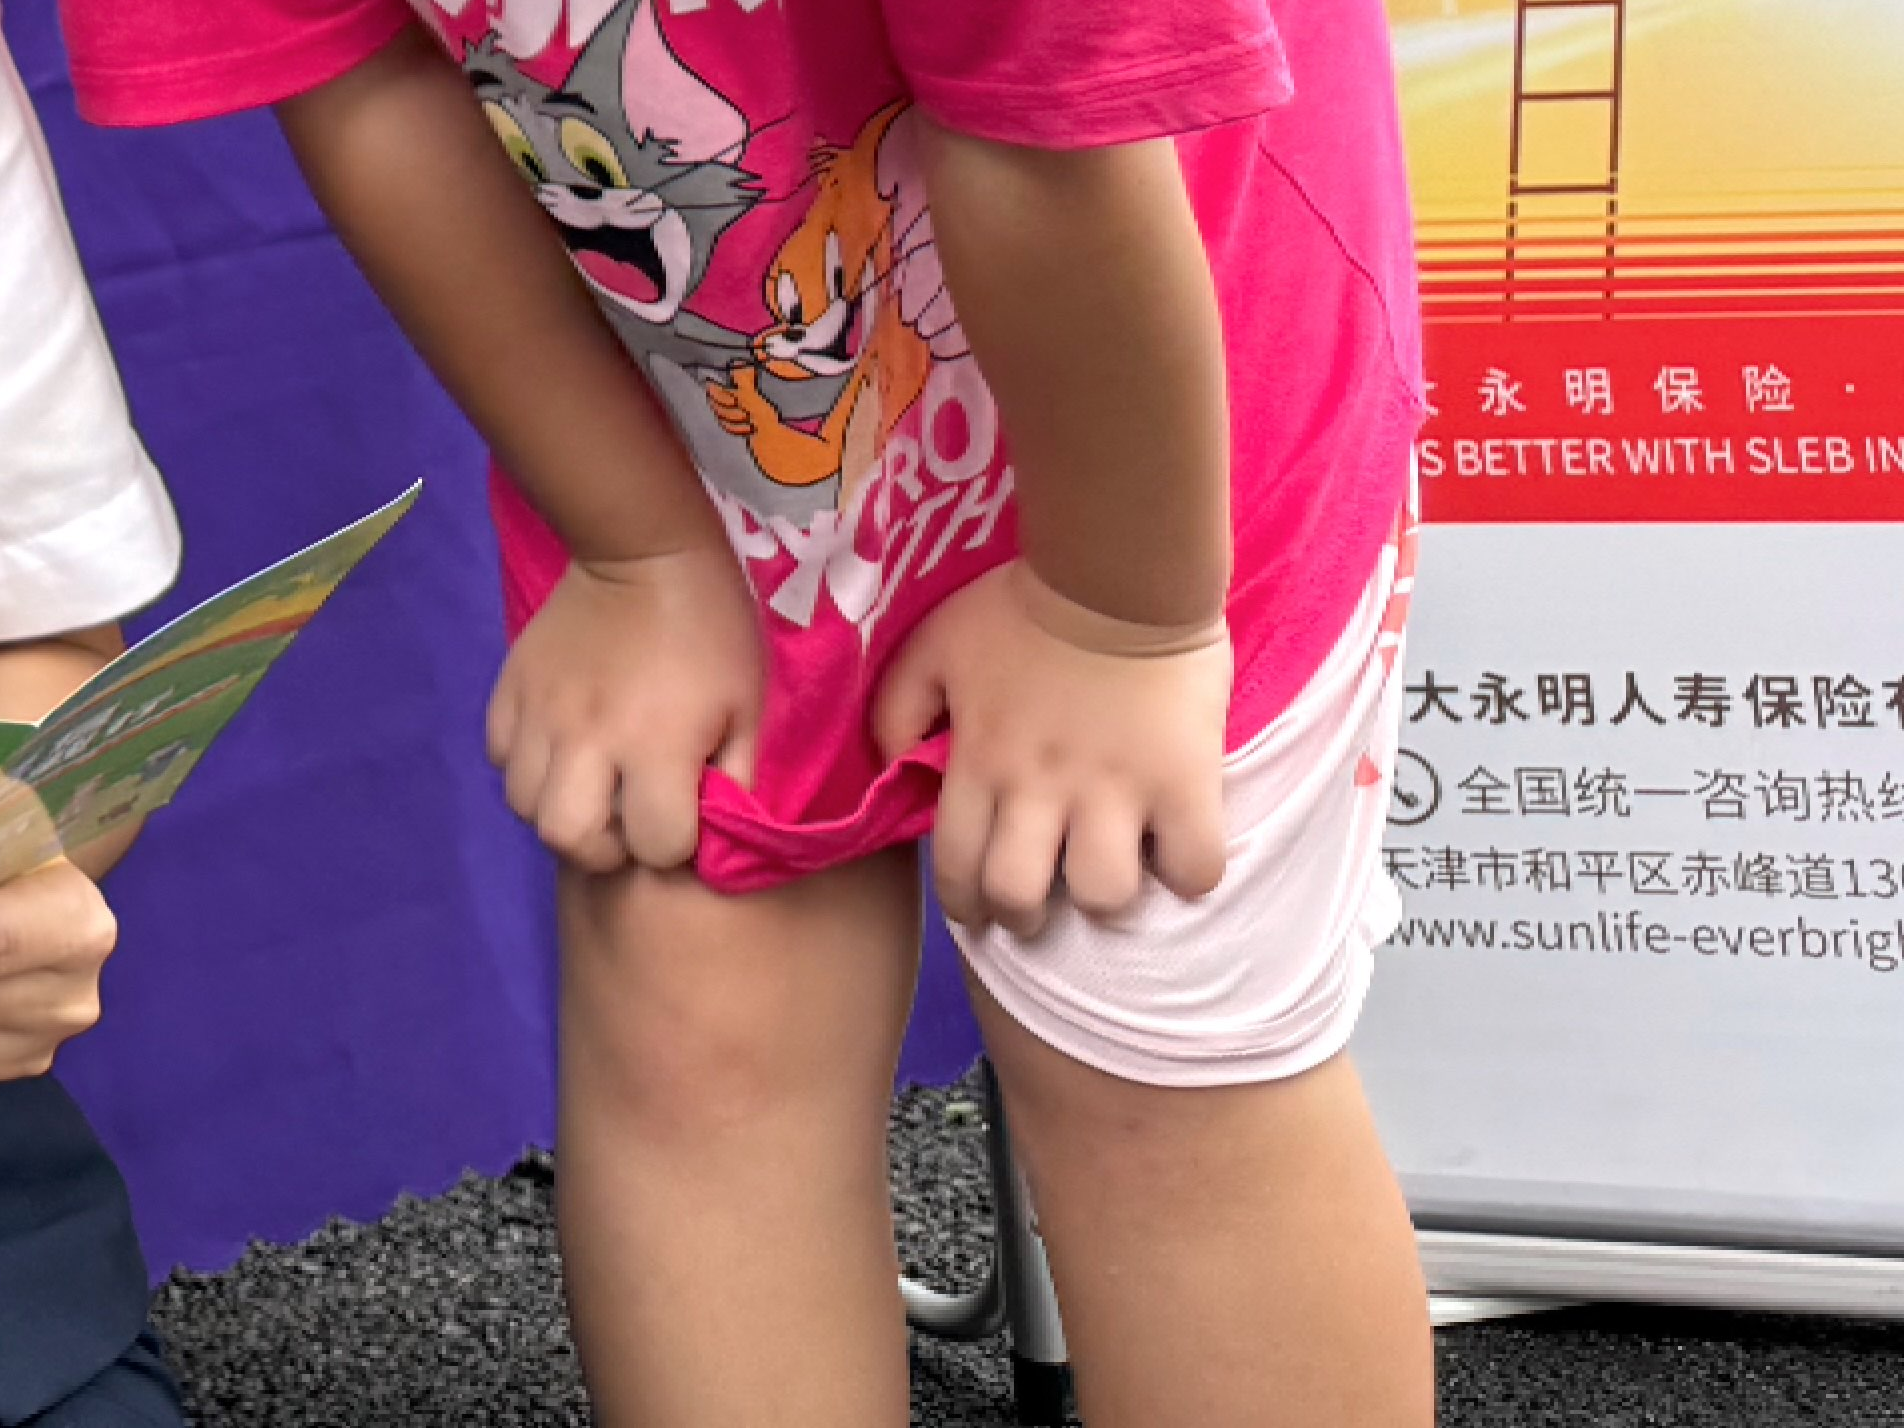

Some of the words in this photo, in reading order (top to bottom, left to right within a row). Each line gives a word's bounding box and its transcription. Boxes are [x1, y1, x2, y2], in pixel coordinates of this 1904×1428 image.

[1420, 439, 1445, 477] S
[1456, 437, 1614, 477] BETTER
[1621, 437, 1734, 476] WITH
[1744, 435, 1854, 475] SLEB
[1381, 844, 1904, 901] 天津市和平区赤峰道13
